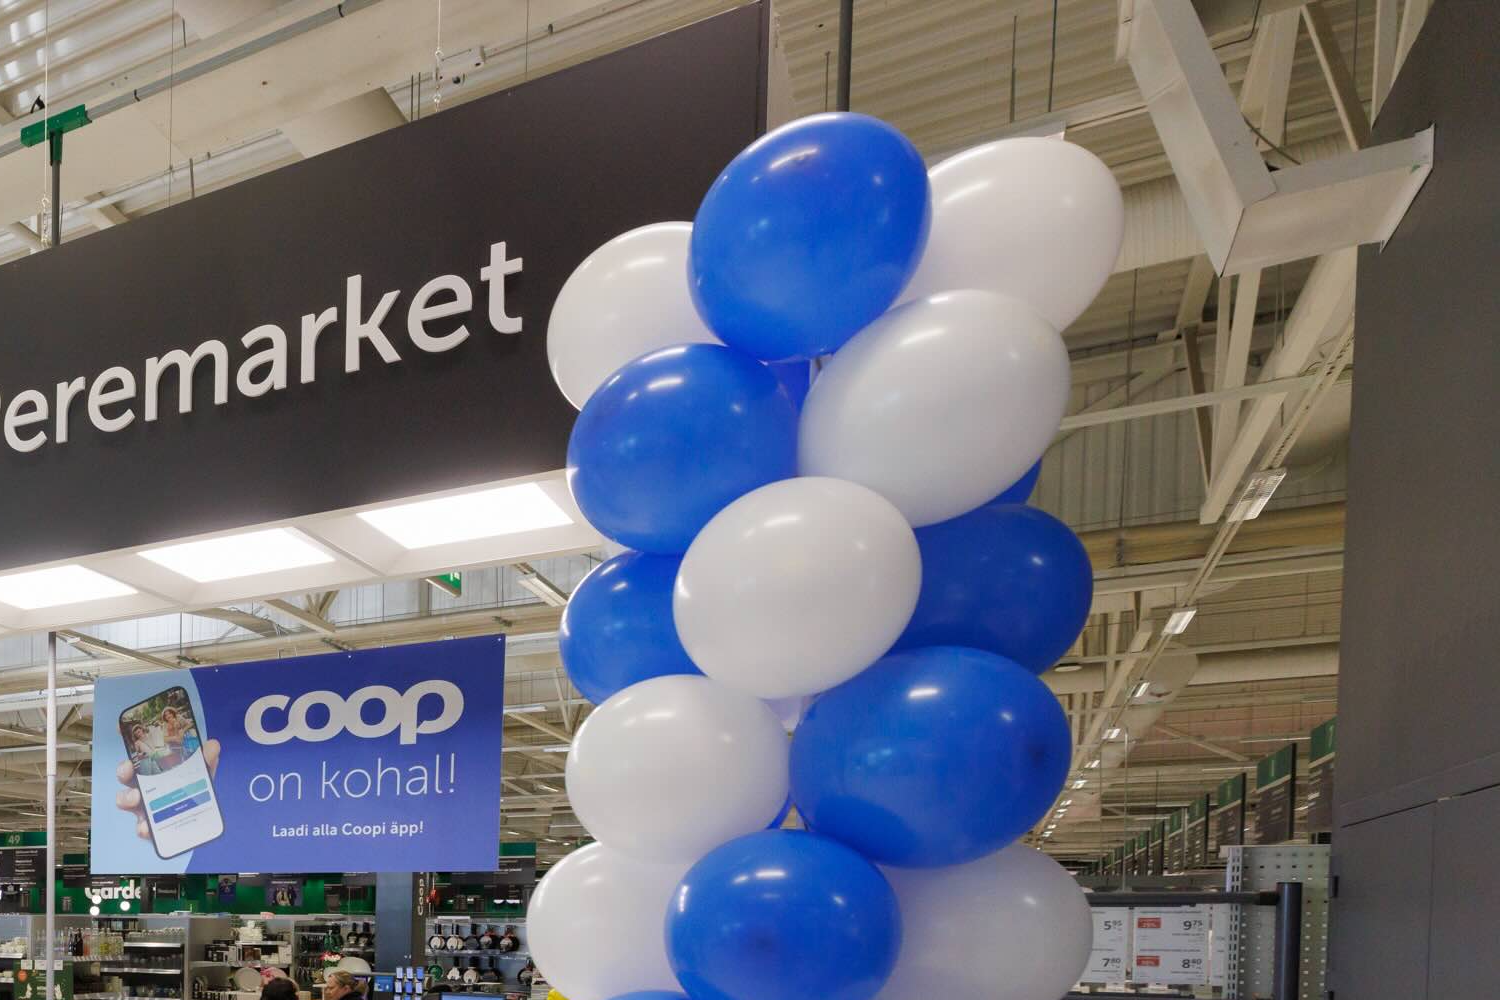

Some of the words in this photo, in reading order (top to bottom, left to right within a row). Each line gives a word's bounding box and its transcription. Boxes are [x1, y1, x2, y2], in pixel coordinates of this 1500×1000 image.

[243, 679, 465, 745] coop
[248, 772, 301, 802] on
[321, 752, 456, 800] kohal!
[8, 834, 21, 845] 49
[271, 824, 309, 837] Laadi
[312, 823, 338, 836] alla
[341, 821, 386, 839] Coopi
[389, 821, 425, 839] äpp!
